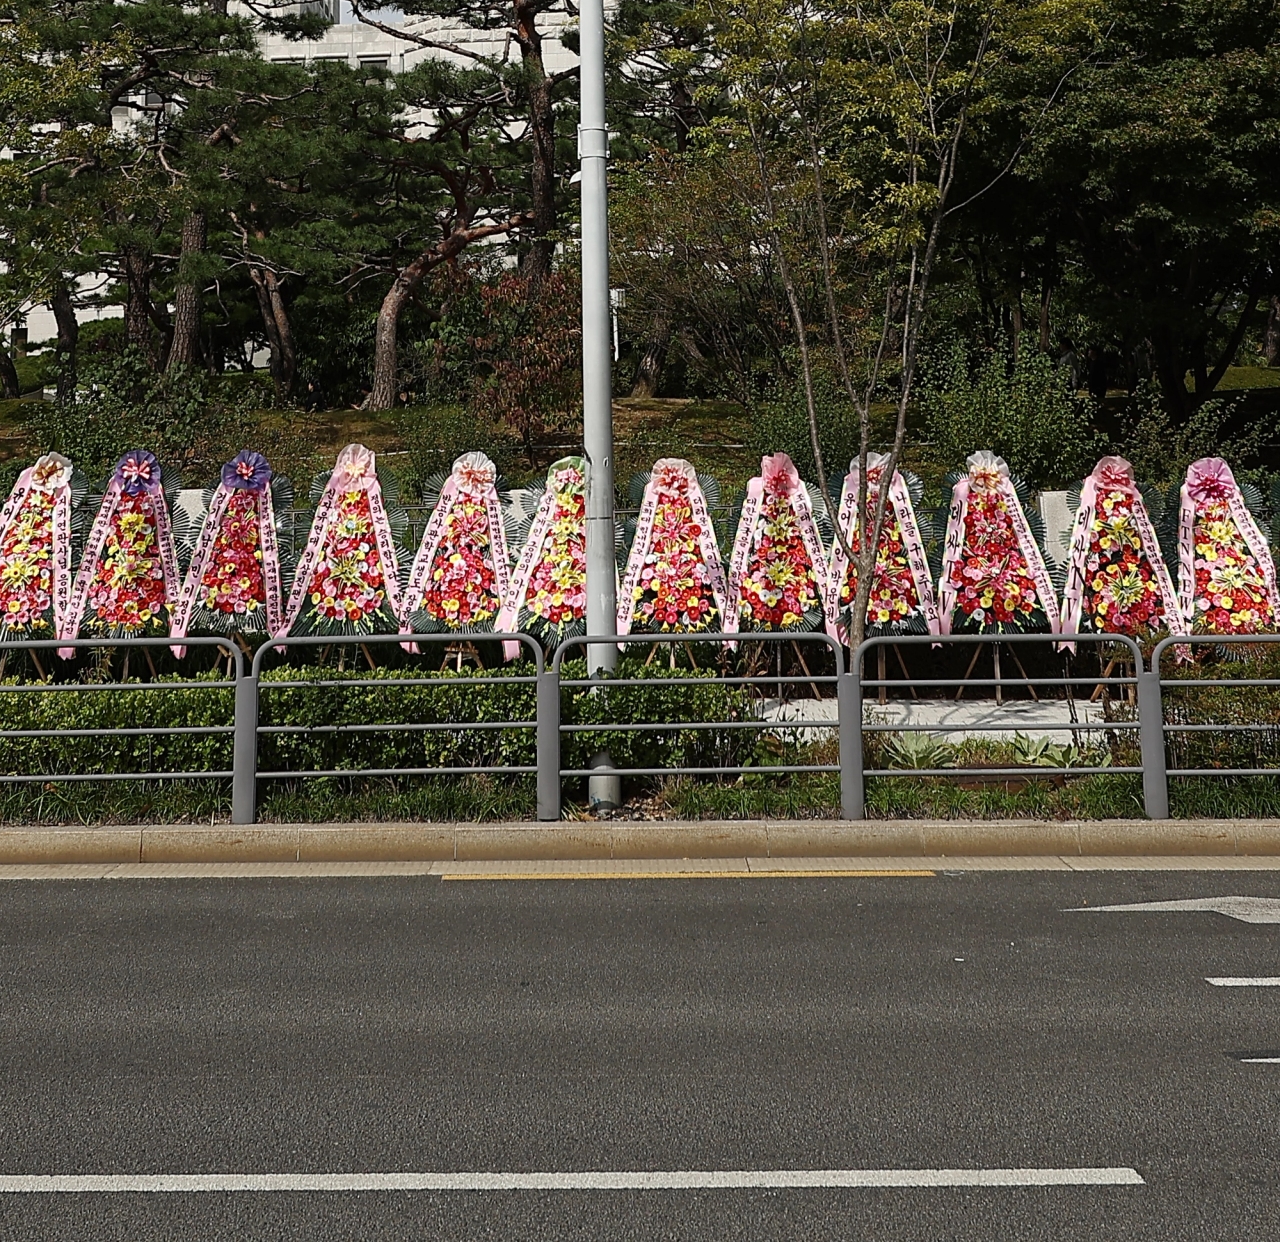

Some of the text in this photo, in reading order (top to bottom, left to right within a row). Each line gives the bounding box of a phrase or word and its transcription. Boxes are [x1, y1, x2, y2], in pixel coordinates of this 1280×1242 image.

[55, 495, 71, 570] 지귀연판사님
[305, 486, 336, 546] 신자유연대
[367, 493, 386, 525] 정의는
[410, 494, 452, 592] 반공사관학교생도
[797, 493, 813, 522] 조희대
[174, 493, 227, 630] 경기하남시민 이정미
[288, 549, 314, 601] 김상진팬
[502, 493, 556, 612] 윤어게인 긍정의 아이콘
[895, 491, 940, 621] 나라를 구해주세요
